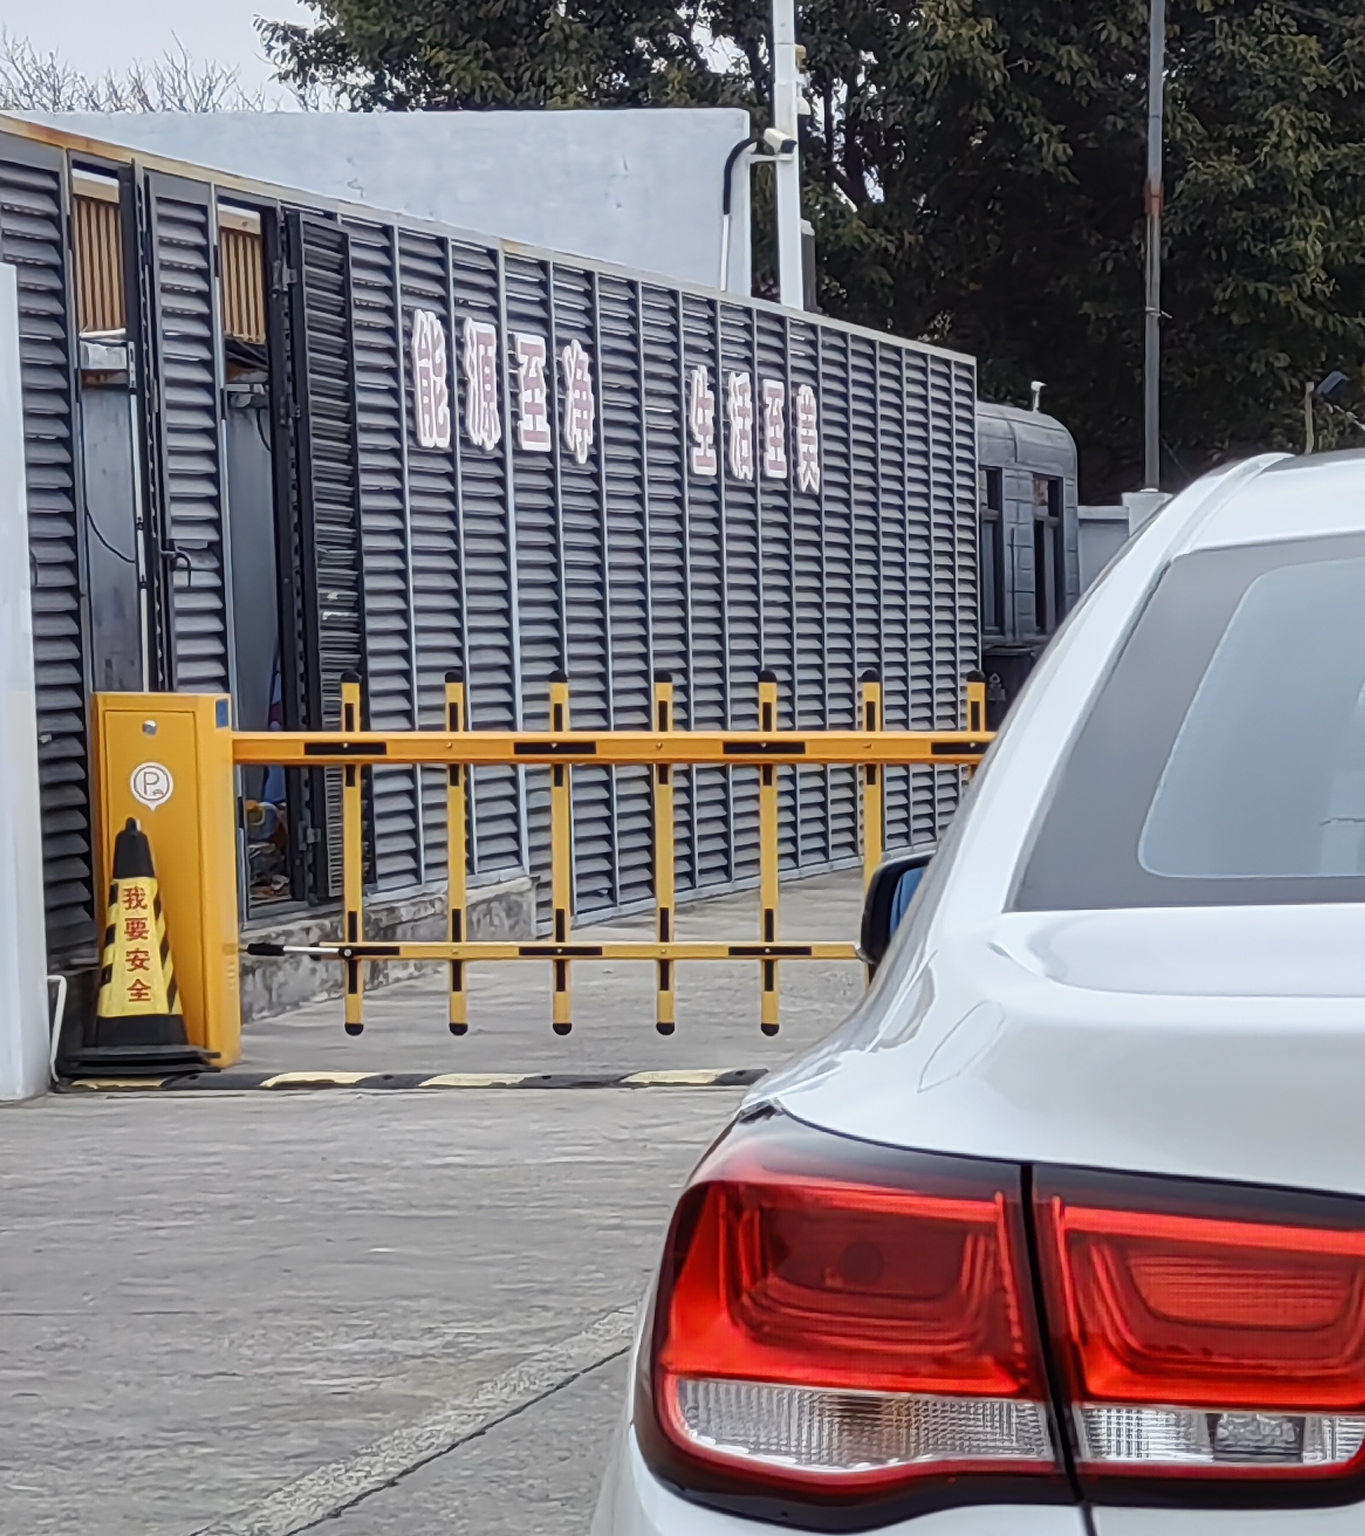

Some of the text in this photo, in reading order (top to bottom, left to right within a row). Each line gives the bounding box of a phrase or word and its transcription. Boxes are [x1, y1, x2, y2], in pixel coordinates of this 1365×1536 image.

[411, 308, 821, 496] 能源至净 生活至美
[122, 885, 151, 1003] 我要安全
